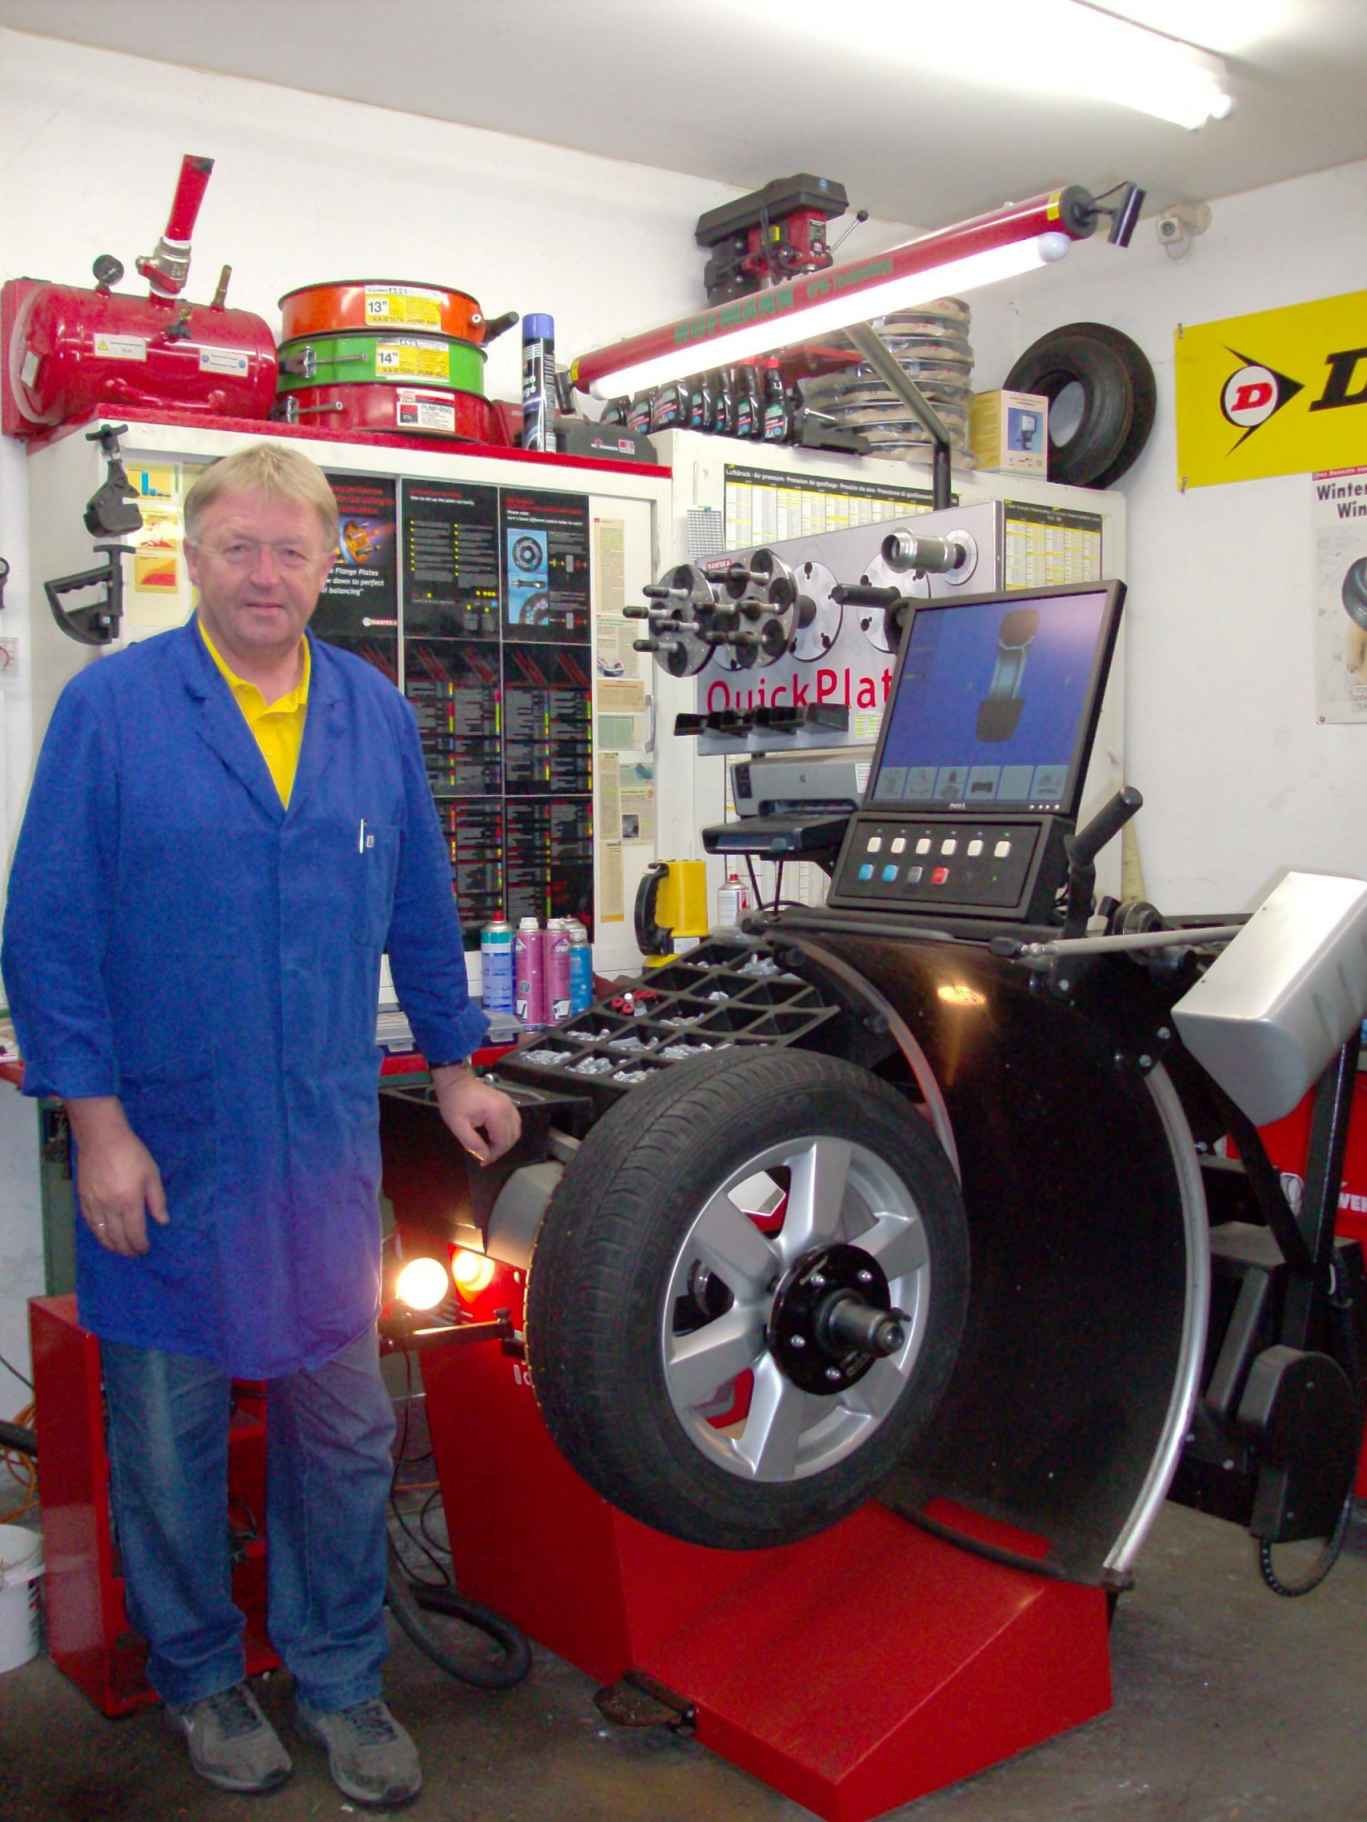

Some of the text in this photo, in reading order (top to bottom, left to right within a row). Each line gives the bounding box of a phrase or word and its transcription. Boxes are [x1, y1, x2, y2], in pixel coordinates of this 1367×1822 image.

[368, 301, 388, 313] 13"
[378, 352, 398, 364] 14"
[1230, 382, 1273, 412] D
